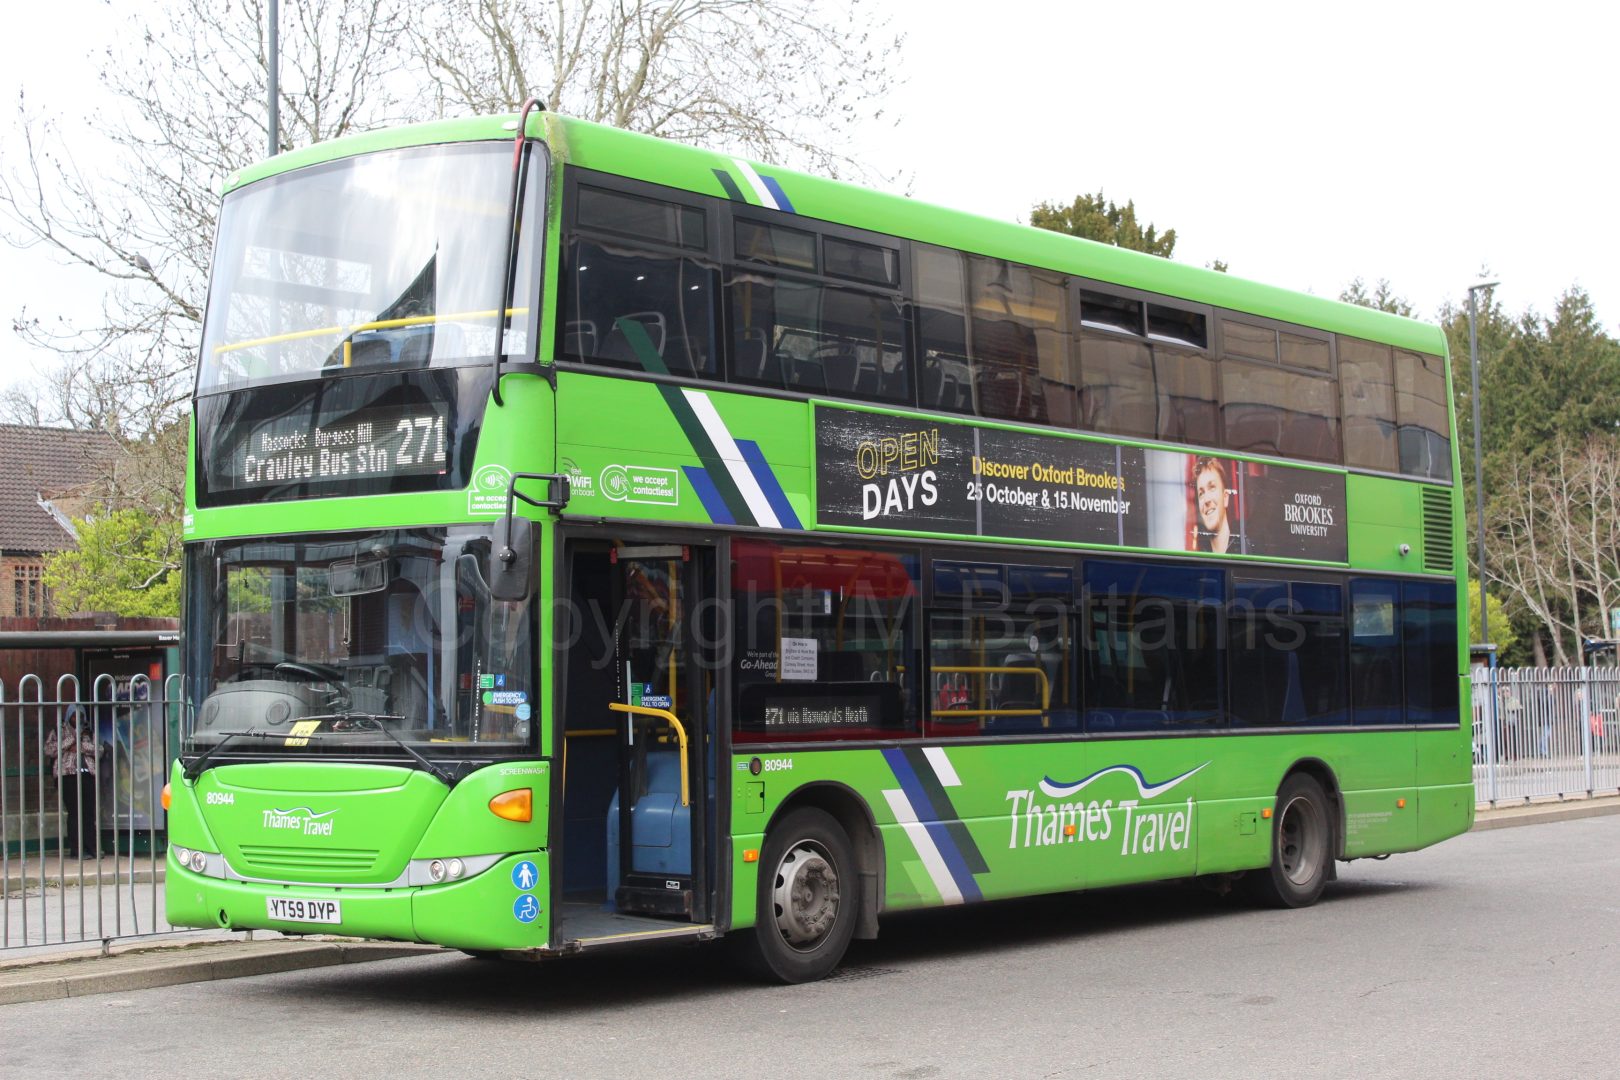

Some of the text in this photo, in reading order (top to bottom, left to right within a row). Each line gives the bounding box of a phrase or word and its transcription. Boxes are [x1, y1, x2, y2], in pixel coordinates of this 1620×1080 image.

[262, 422, 372, 451] Hassocks Burgess Hill
[396, 415, 446, 465] 271
[244, 444, 388, 482] Crawley Bus Stn
[856, 428, 938, 479] OPEN
[572, 476, 592, 489] WiFi
[632, 475, 668, 487] we accept
[972, 456, 1125, 490] Discover Oxford Brookes
[486, 495, 507, 503] accep
[633, 486, 674, 497] contactless!
[862, 470, 938, 521] DAYS
[966, 482, 1131, 515] 25 October & 15 November
[1294, 493, 1321, 505] OXFORD
[1284, 504, 1333, 525] BROOKES
[1290, 524, 1328, 537] UNIVERSITY
[740, 659, 779, 670] Go-Ahead
[499, 767, 546, 776] SCREENWASH
[764, 758, 793, 772] 80944
[206, 792, 235, 805] 80944
[262, 809, 334, 836] Thames Travel
[1005, 789, 1192, 856] Thames Travel
[271, 899, 336, 920] YT59 DYP
